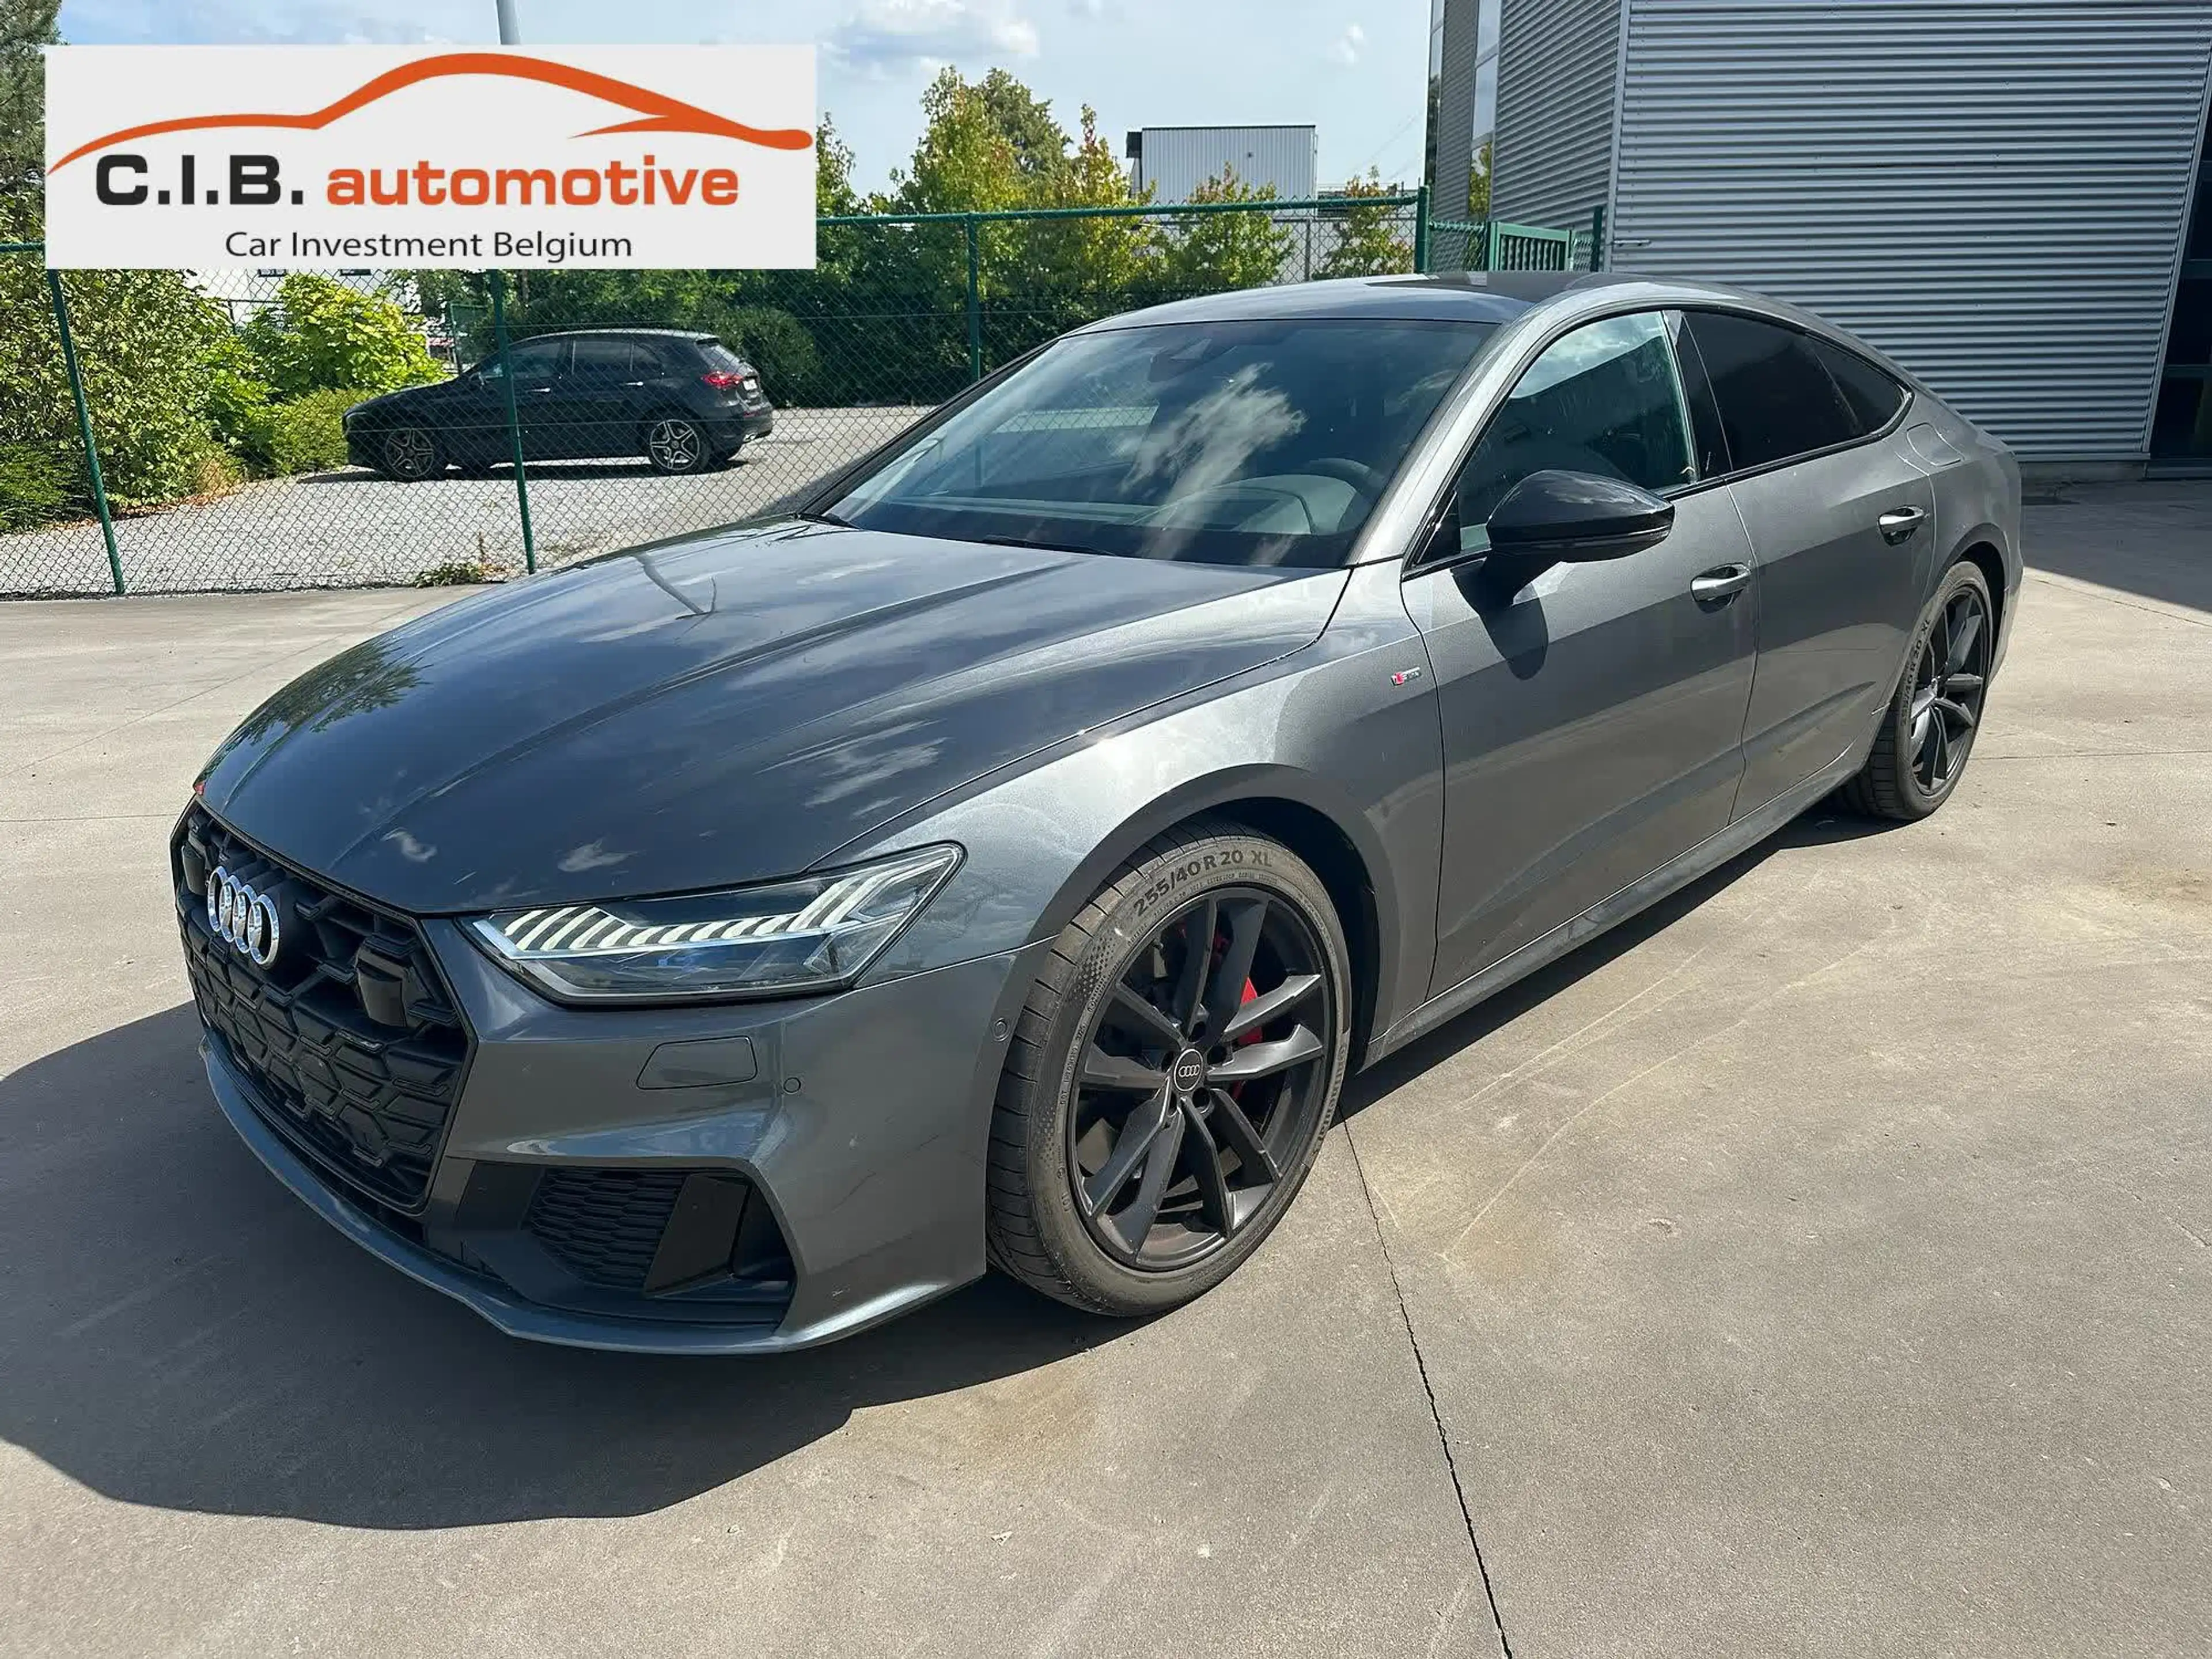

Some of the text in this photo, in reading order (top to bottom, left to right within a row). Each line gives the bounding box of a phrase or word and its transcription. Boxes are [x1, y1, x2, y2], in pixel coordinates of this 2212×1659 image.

[1133, 861, 1201, 917] 255/40
[1203, 855, 1217, 870] R
[1220, 850, 1244, 866] 20
[1252, 850, 1273, 868] XL
